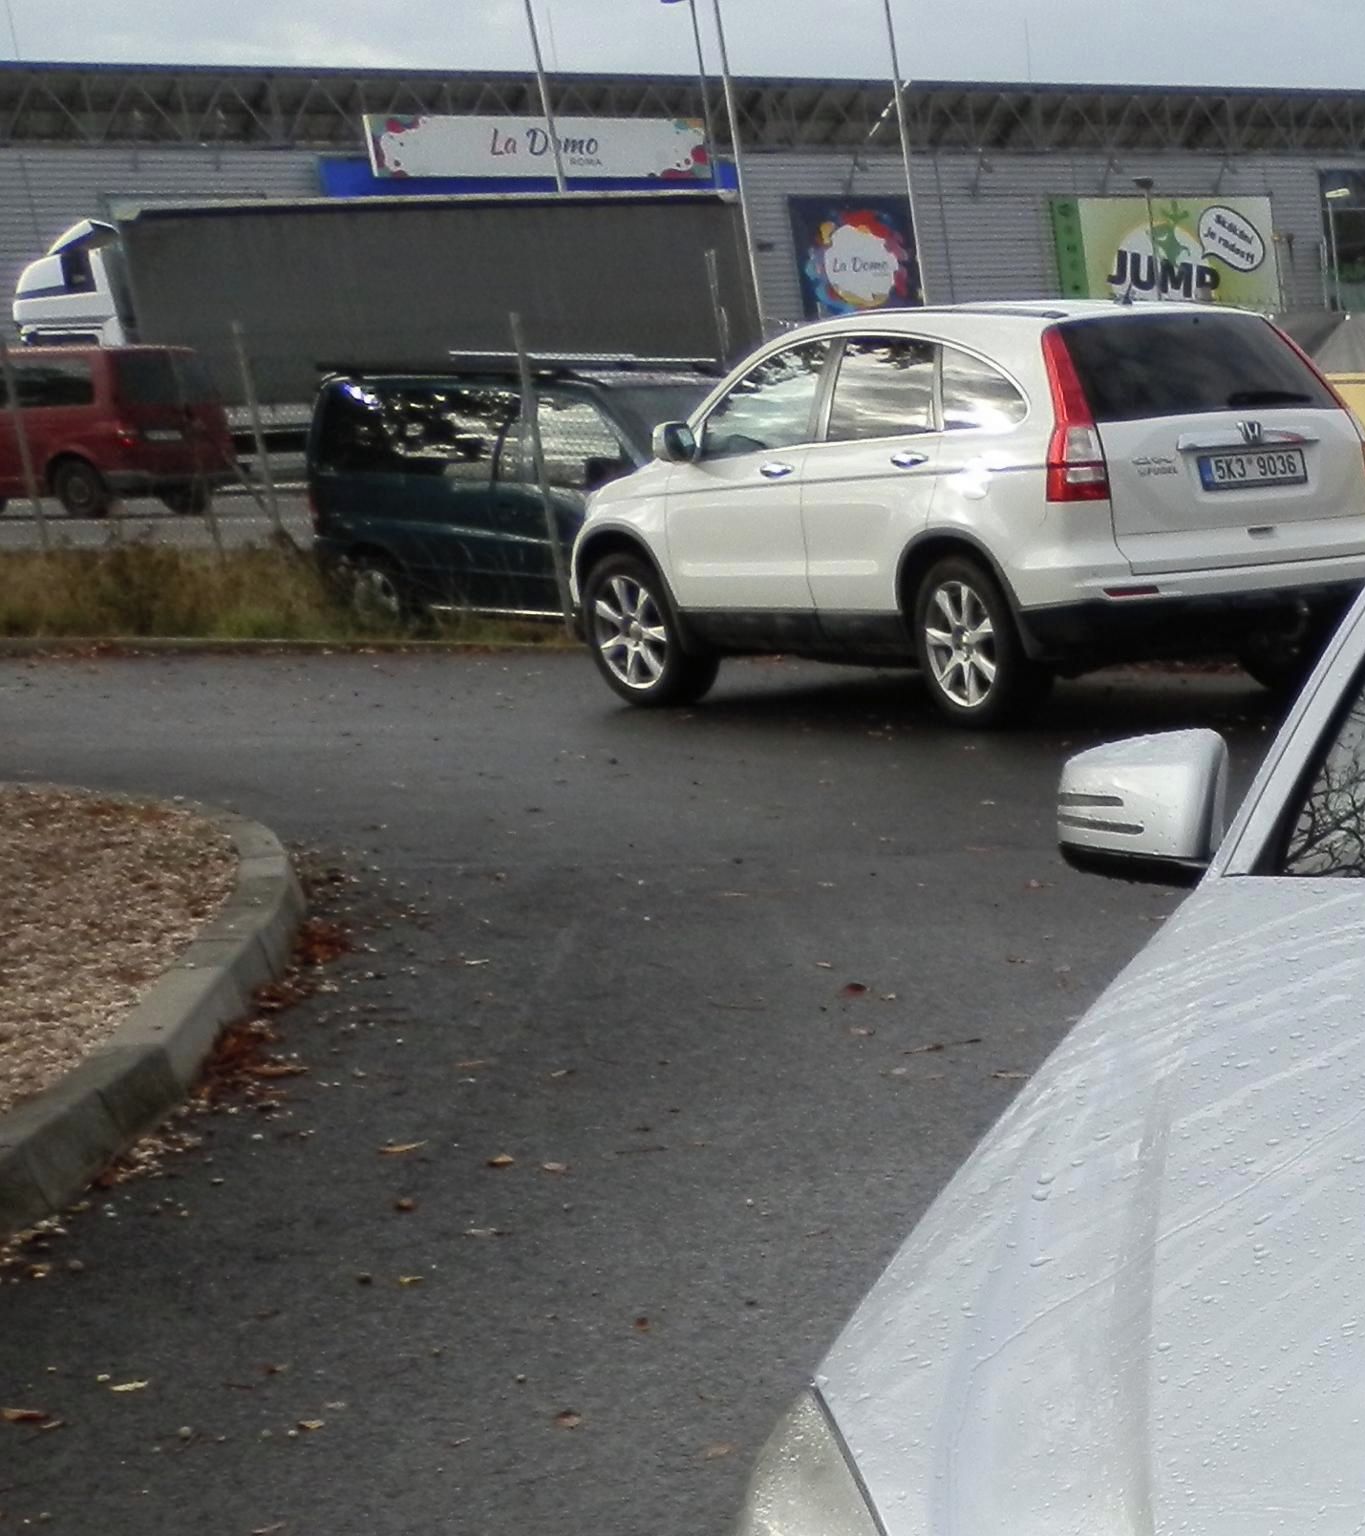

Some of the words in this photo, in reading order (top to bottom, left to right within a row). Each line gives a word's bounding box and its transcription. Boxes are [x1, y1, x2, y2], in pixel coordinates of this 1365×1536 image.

[490, 128, 517, 156] La
[1107, 249, 1220, 299] JUMP
[1214, 457, 1247, 480] 5K3
[1257, 455, 1297, 477] 9036
